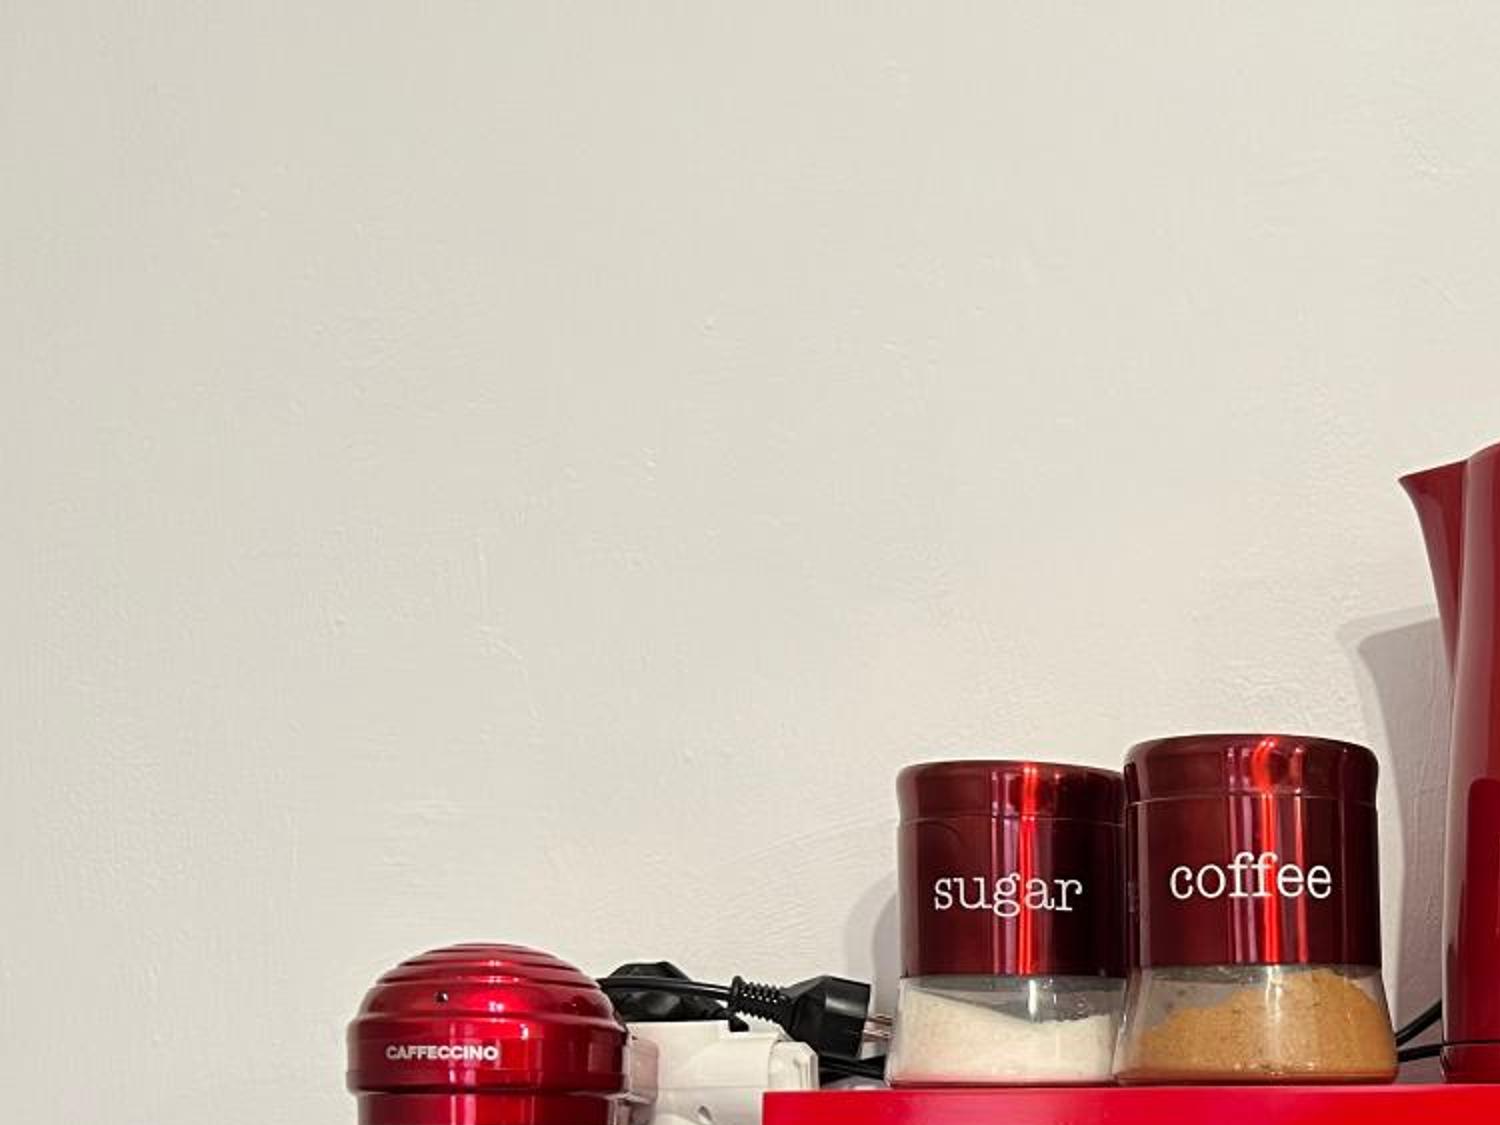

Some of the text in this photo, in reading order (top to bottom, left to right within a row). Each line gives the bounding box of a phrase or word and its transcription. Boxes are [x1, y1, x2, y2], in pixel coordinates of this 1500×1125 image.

[934, 873, 1082, 917] sugar
[1170, 852, 1332, 899] coffee
[386, 1045, 499, 1061] CAFFECCINO
